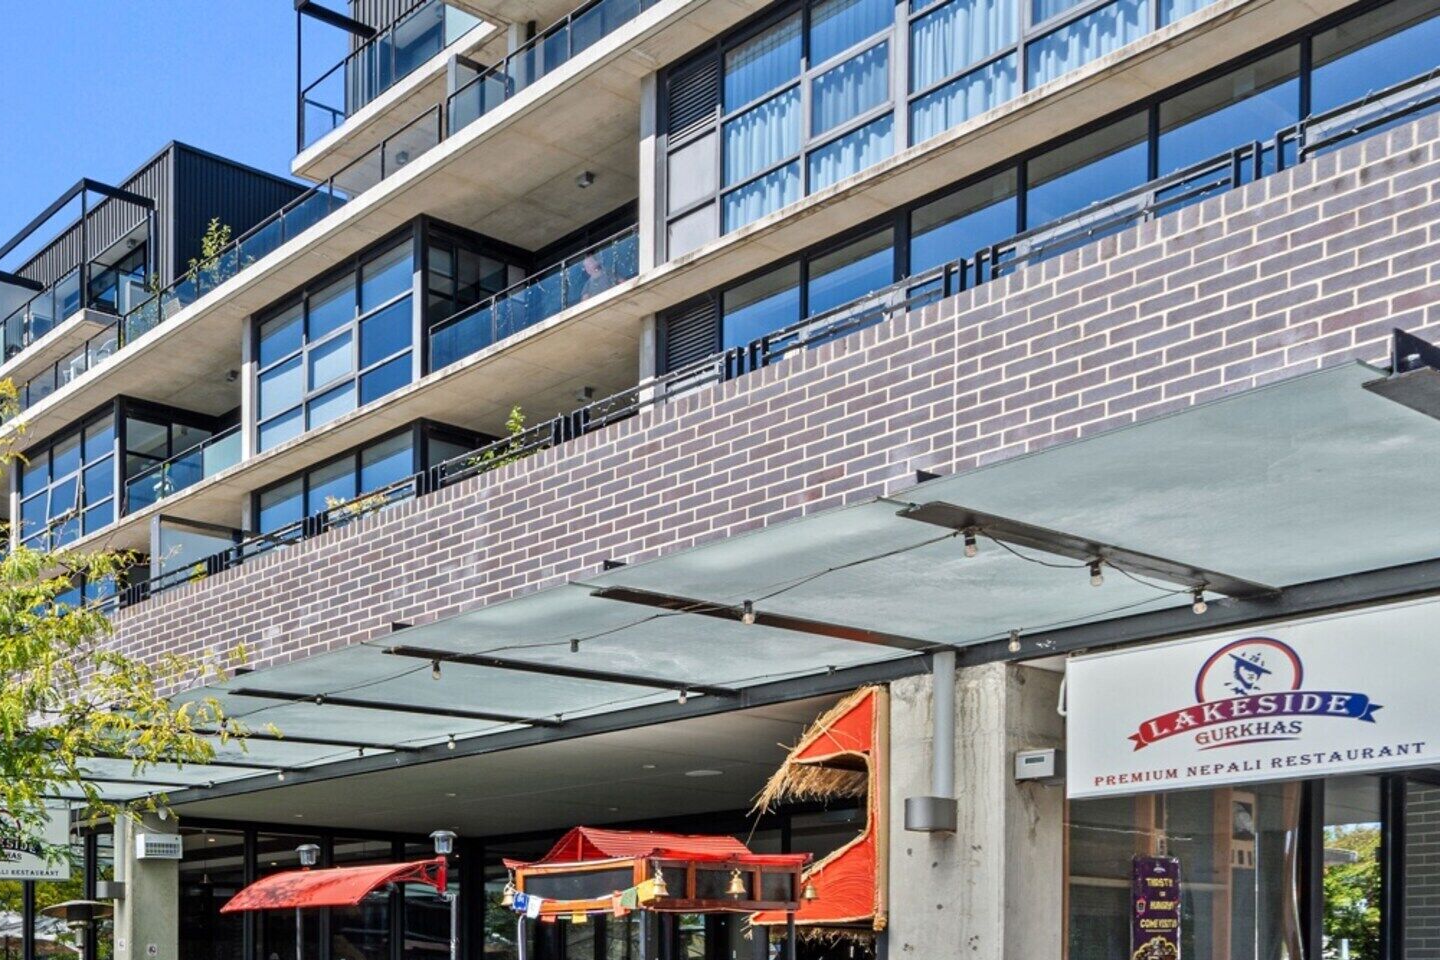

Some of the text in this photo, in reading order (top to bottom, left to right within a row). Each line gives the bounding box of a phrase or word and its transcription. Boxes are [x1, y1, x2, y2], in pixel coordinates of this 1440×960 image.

[1148, 693, 1352, 738] LAKESIDE
[1194, 720, 1303, 745] GURKHAS
[1094, 742, 1426, 786] PREMIUM NEPALI RESTAURANT
[11, 868, 60, 877] RESTAURANT
